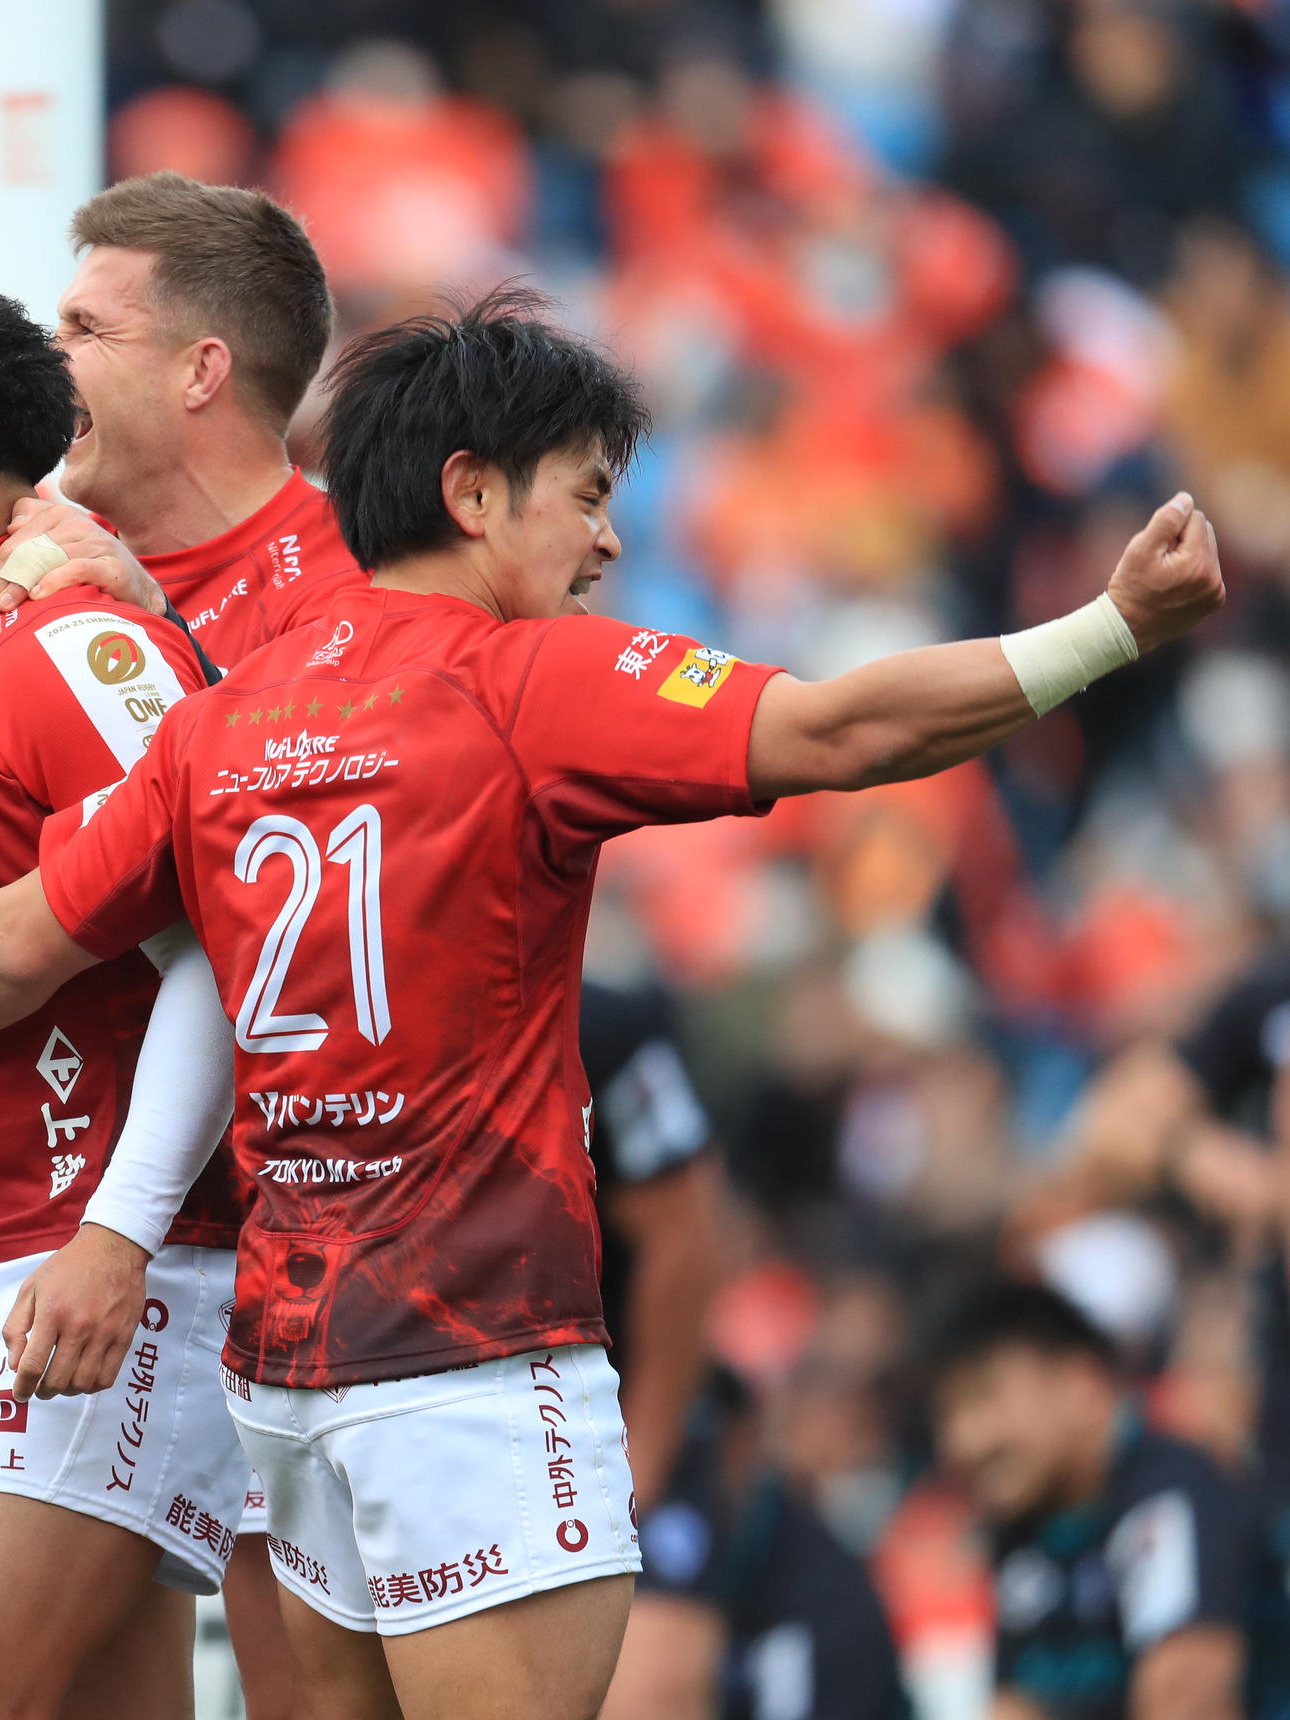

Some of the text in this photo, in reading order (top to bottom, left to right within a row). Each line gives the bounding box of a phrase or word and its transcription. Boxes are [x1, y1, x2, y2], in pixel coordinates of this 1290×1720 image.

[234, 804, 392, 1054] 21
[257, 1158, 326, 1184] TOKYO
[106, 1341, 159, 1491] 中外テクノス
[530, 1354, 578, 1509] 中外テクノス
[165, 1493, 237, 1561] 能美防
[368, 1543, 509, 1609] 能美防災
